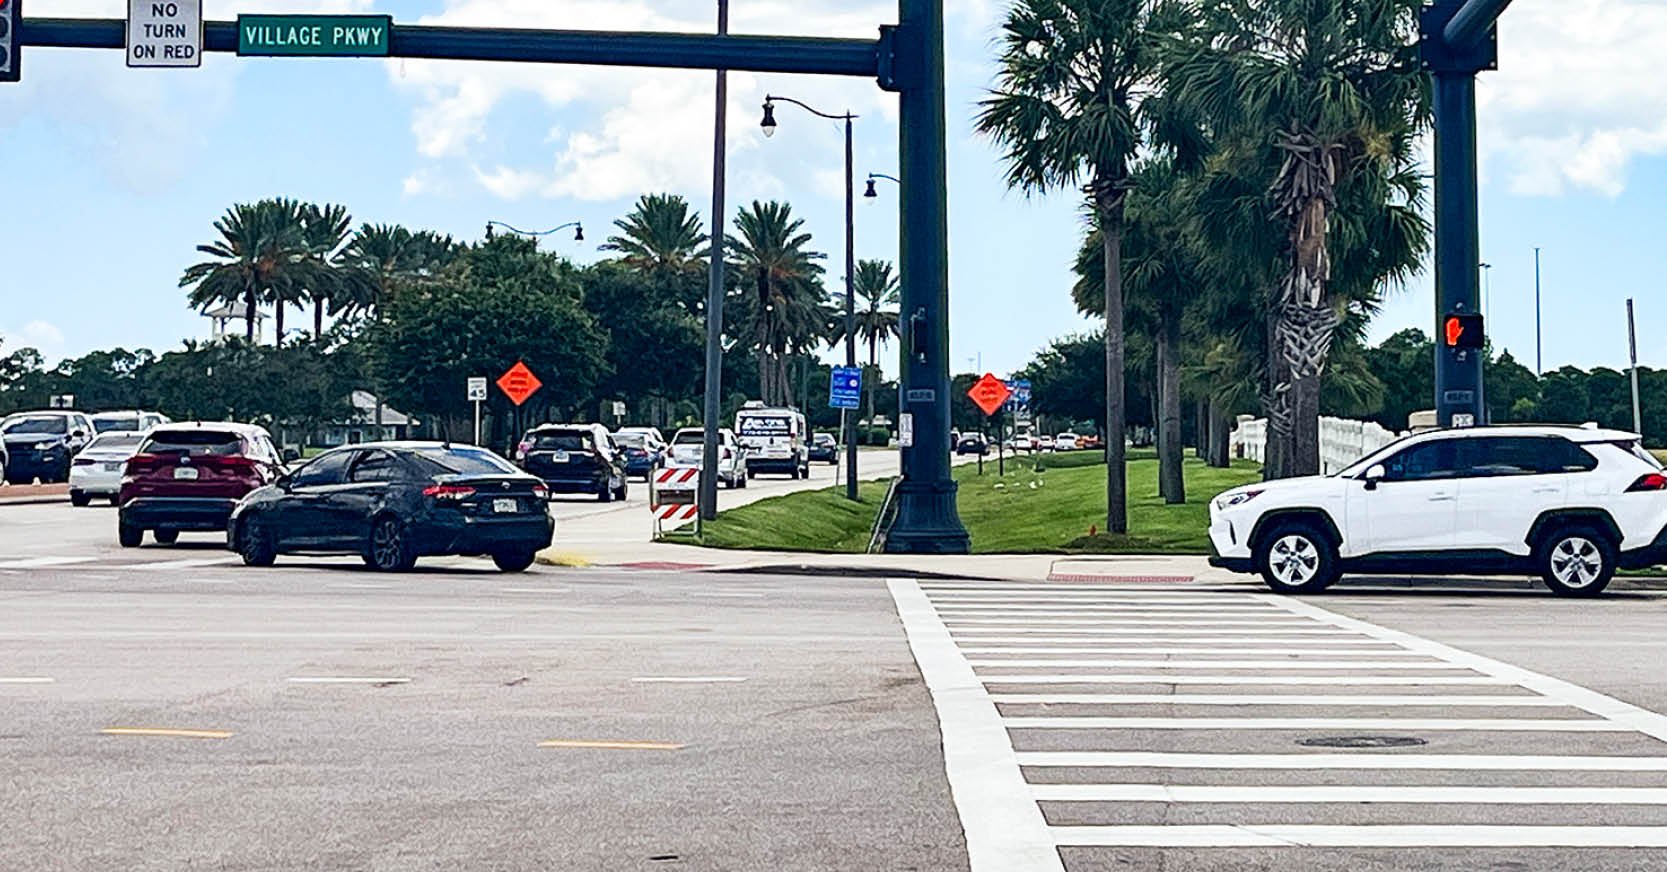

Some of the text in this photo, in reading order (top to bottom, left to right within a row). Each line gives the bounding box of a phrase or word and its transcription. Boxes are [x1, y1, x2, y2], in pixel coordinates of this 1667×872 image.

[151, 3, 178, 17] NO
[143, 24, 187, 38] TURN
[245, 26, 383, 46] VILLAGE PKWY
[133, 45, 195, 59] ON RED
[470, 389, 485, 398] 45
